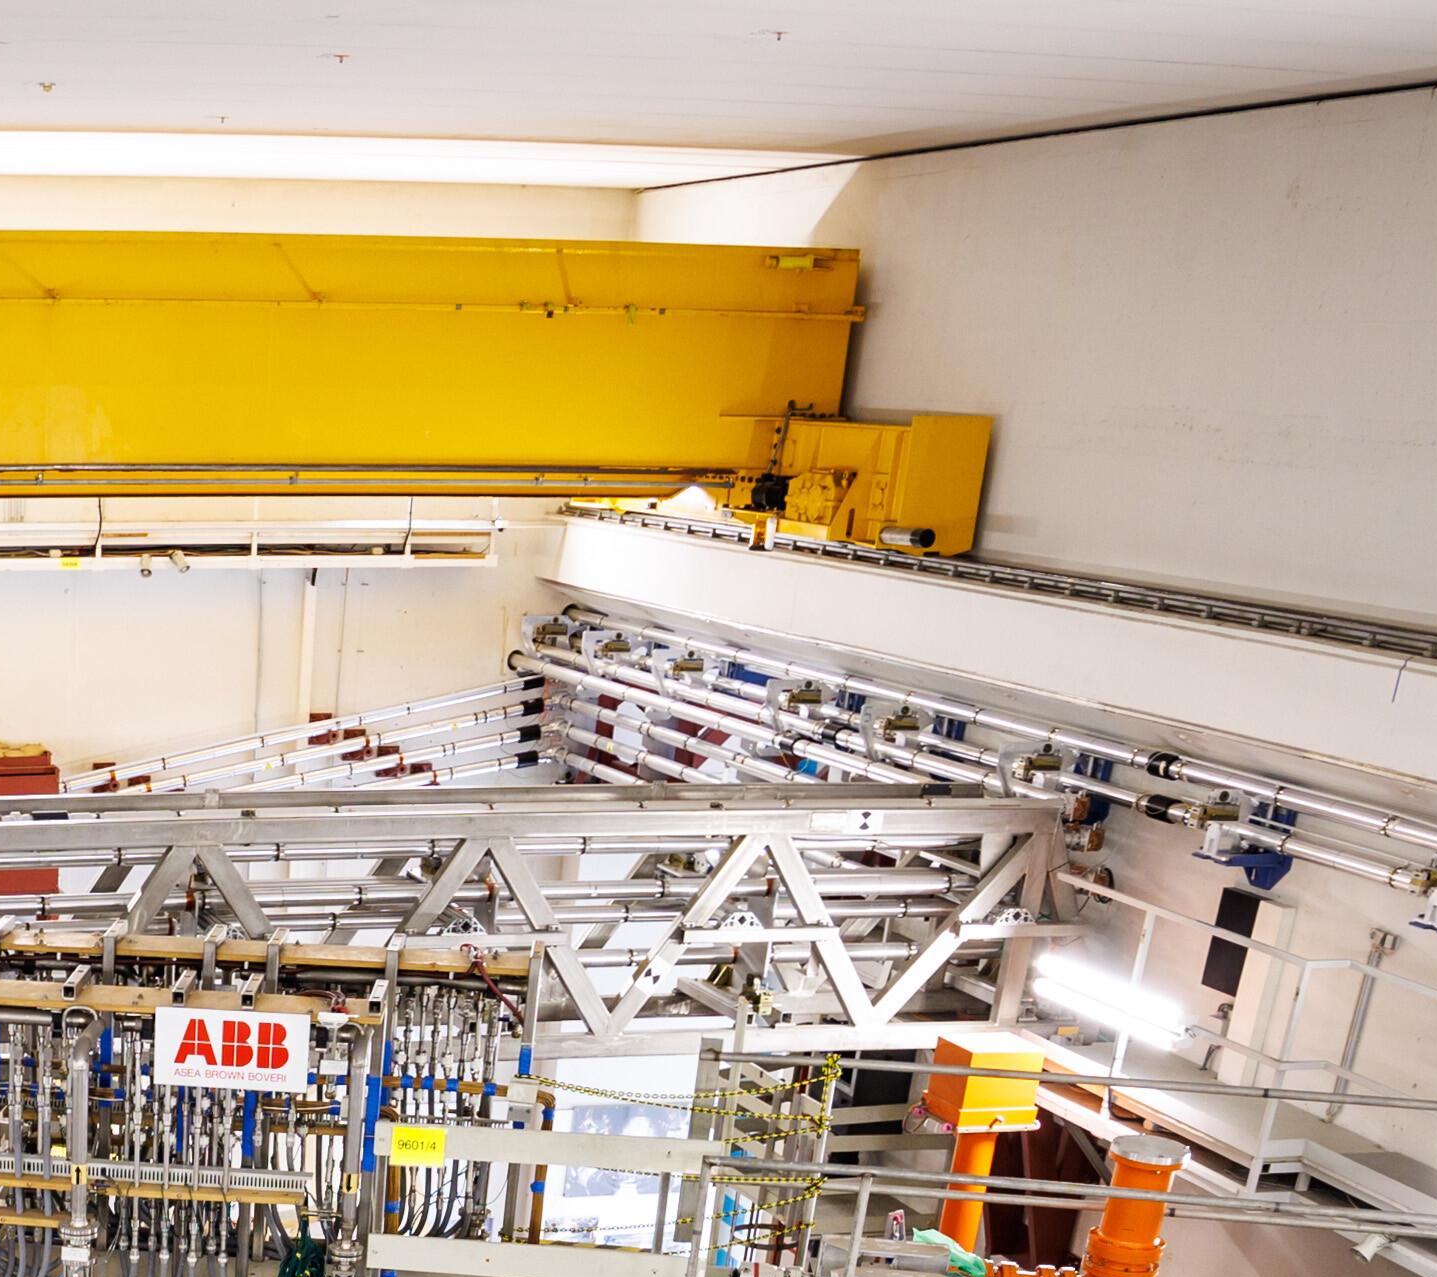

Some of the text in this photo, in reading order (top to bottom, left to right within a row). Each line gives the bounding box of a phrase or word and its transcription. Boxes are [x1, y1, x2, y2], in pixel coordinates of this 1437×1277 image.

[174, 1018, 289, 1070] ABB
[174, 1068, 287, 1083] ASEA BROWN BOVERI
[397, 1138, 437, 1153] 9601/4
